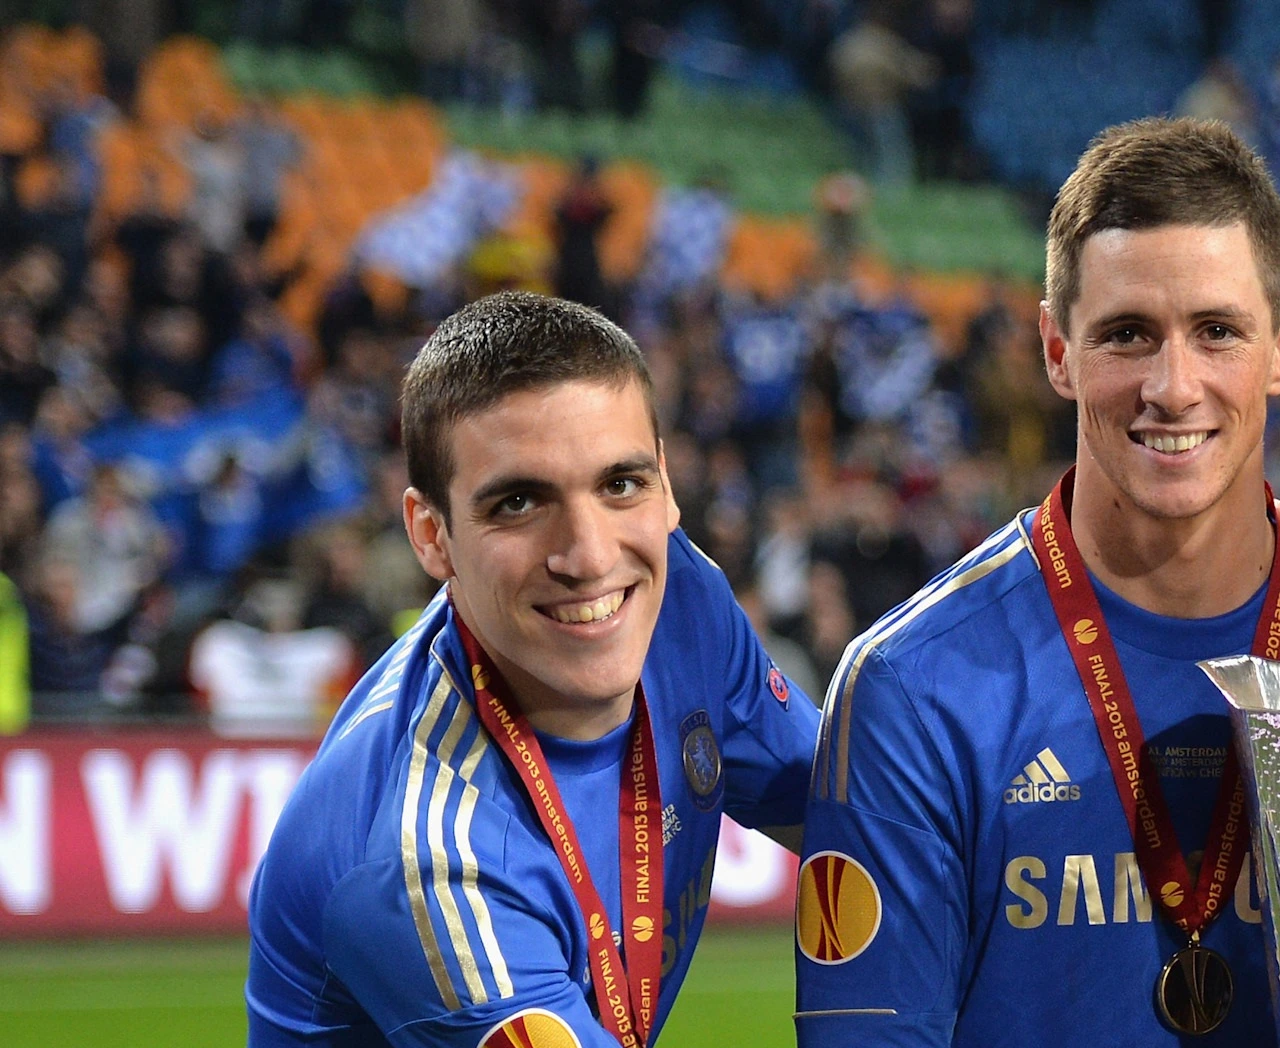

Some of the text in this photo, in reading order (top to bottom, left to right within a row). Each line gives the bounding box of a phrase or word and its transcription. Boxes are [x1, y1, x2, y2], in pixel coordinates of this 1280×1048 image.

[1088, 654, 1108, 703] FINAL
[1103, 701, 1128, 741] 2013
[1117, 740, 1162, 849] amsterdam
[488, 698, 584, 884] FINAL 2013 amsterdam
[1003, 781, 1081, 804] adidas
[635, 814, 650, 854] 2013
[636, 854, 651, 903] FINAL
[598, 948, 617, 997] FINAL
[608, 993, 632, 1033] 2013
